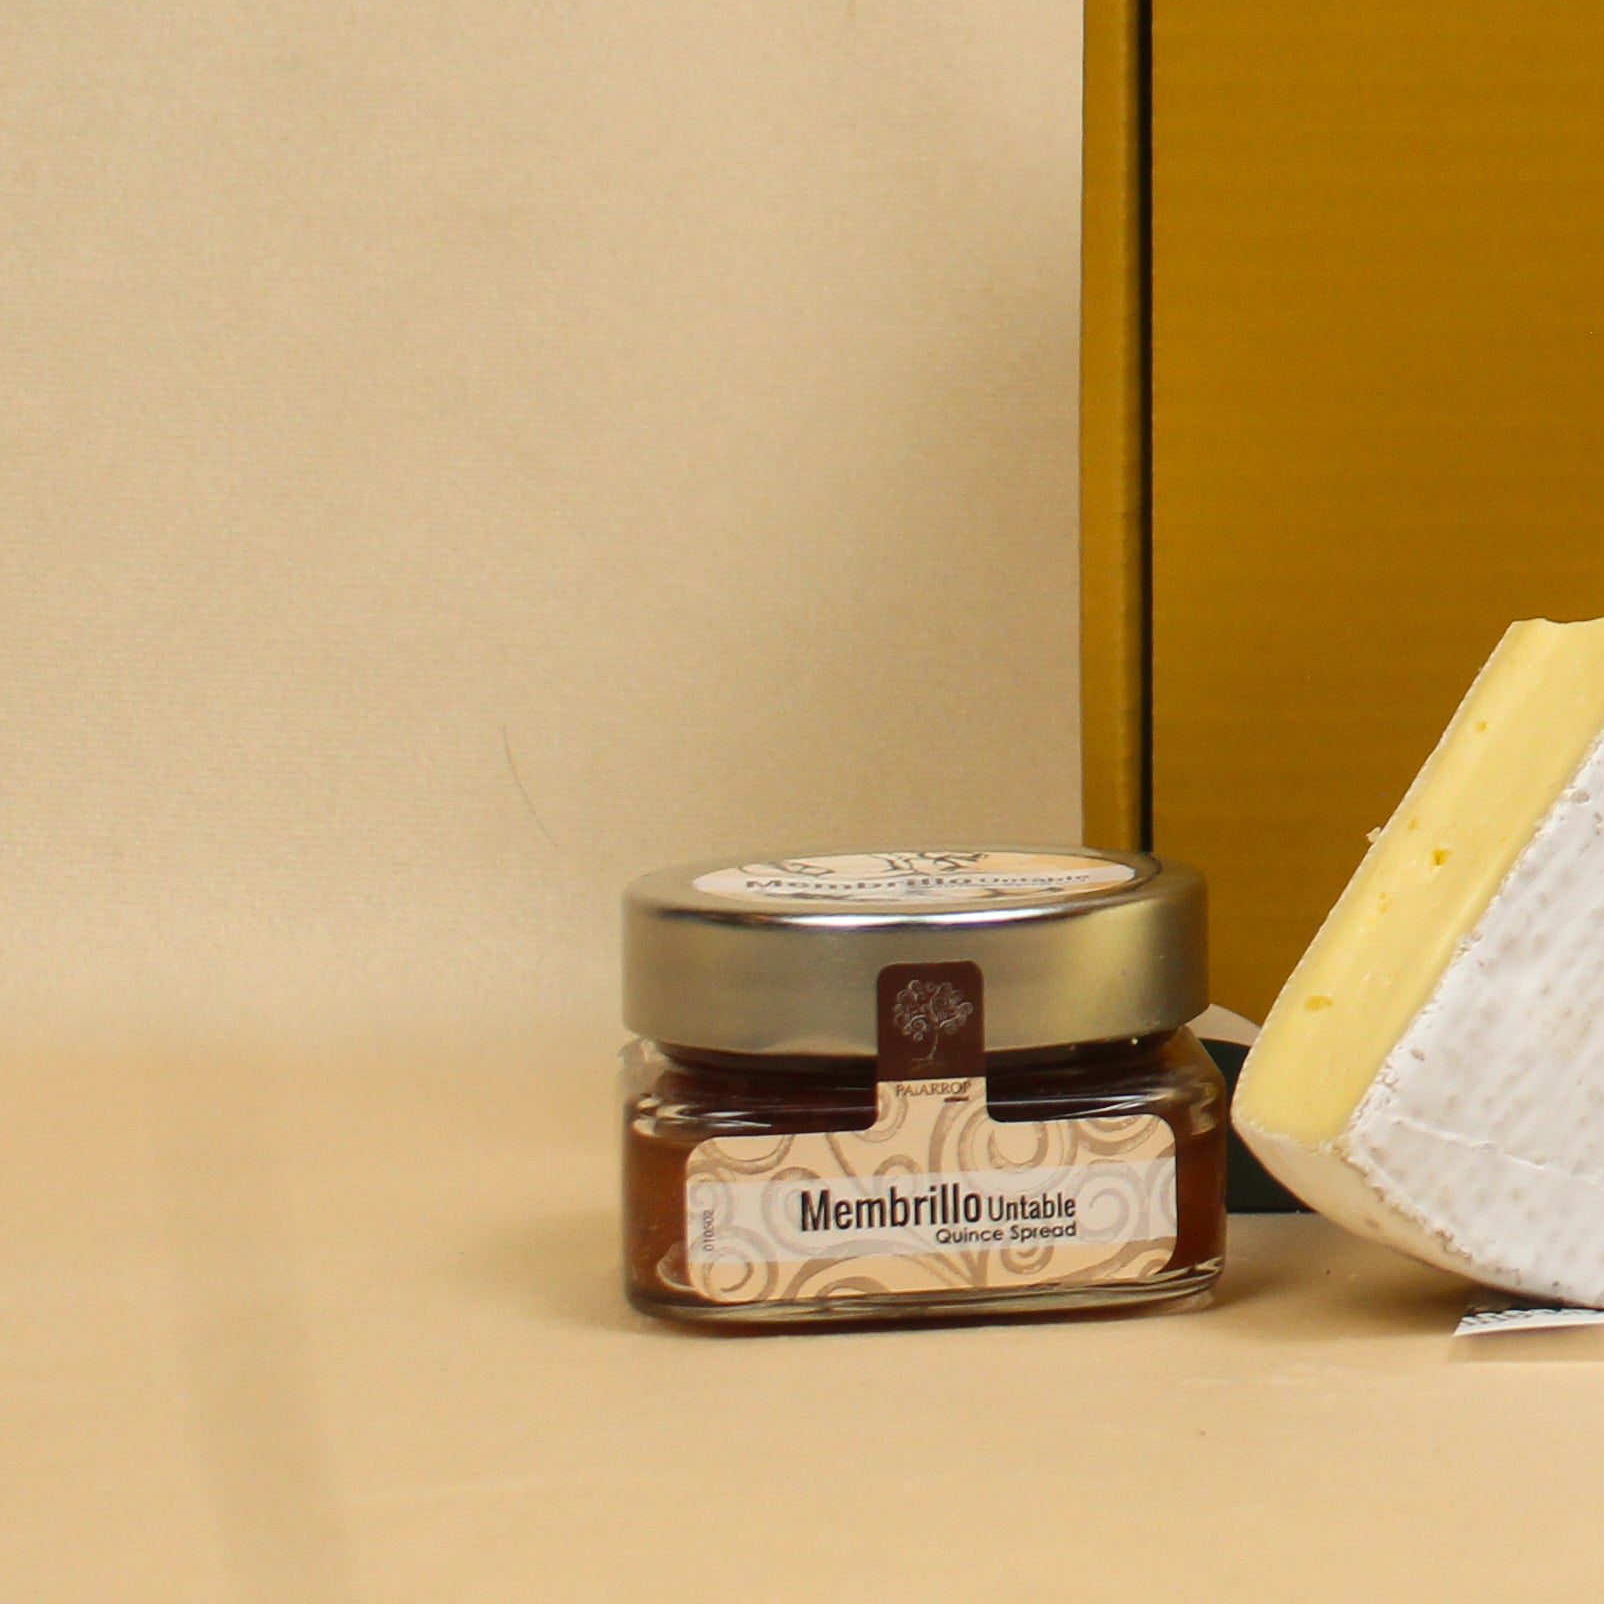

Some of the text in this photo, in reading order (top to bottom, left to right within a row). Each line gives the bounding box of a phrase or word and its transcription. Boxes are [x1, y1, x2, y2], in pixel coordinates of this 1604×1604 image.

[800, 1183, 1077, 1232] Membrillo Untable
[935, 1222, 1077, 1245] Quince Spread
